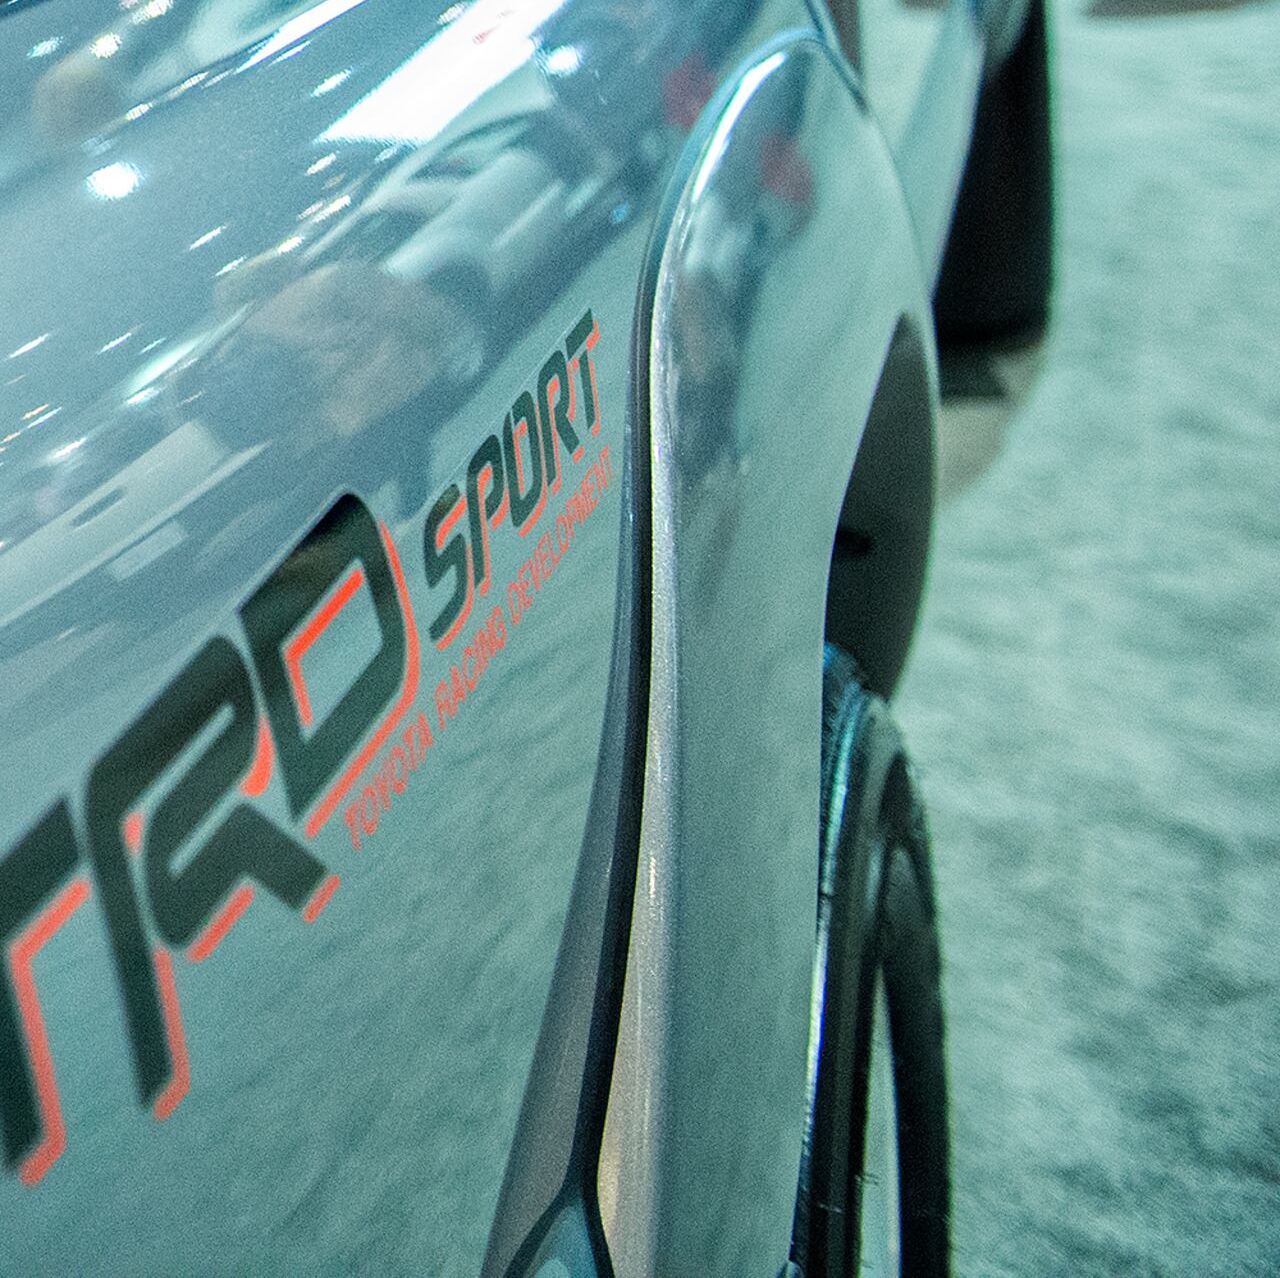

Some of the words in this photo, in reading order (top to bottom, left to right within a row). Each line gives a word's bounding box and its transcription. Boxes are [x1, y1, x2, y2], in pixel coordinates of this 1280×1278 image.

[345, 712, 434, 851] TOYOTA
[434, 606, 507, 730] RACING
[506, 445, 614, 626] DEVELOPMENT
[423, 308, 600, 650] SPORT
